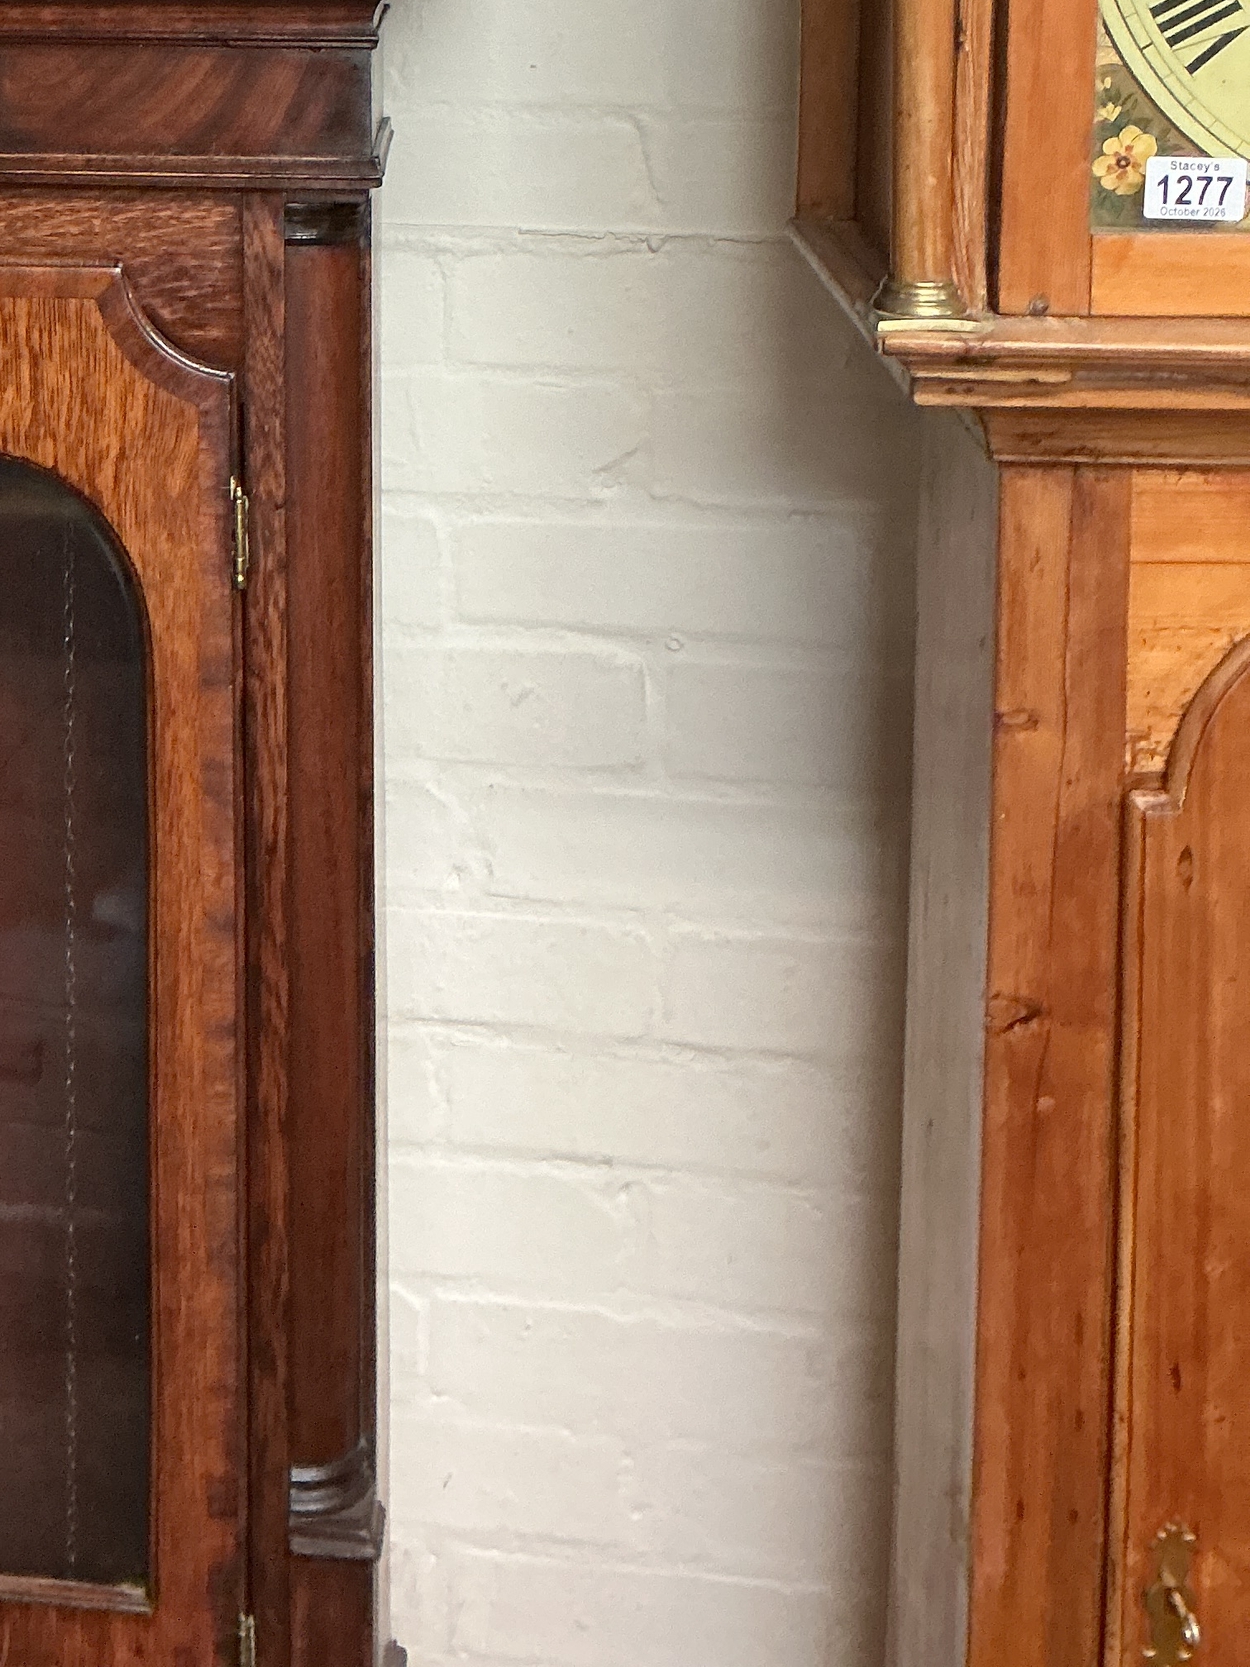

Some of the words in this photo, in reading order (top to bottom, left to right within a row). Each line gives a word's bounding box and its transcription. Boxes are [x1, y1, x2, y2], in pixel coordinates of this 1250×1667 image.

[1170, 160, 1221, 174] Stacey's
[1157, 174, 1235, 207] 1277
[1160, 206, 1201, 217] October
